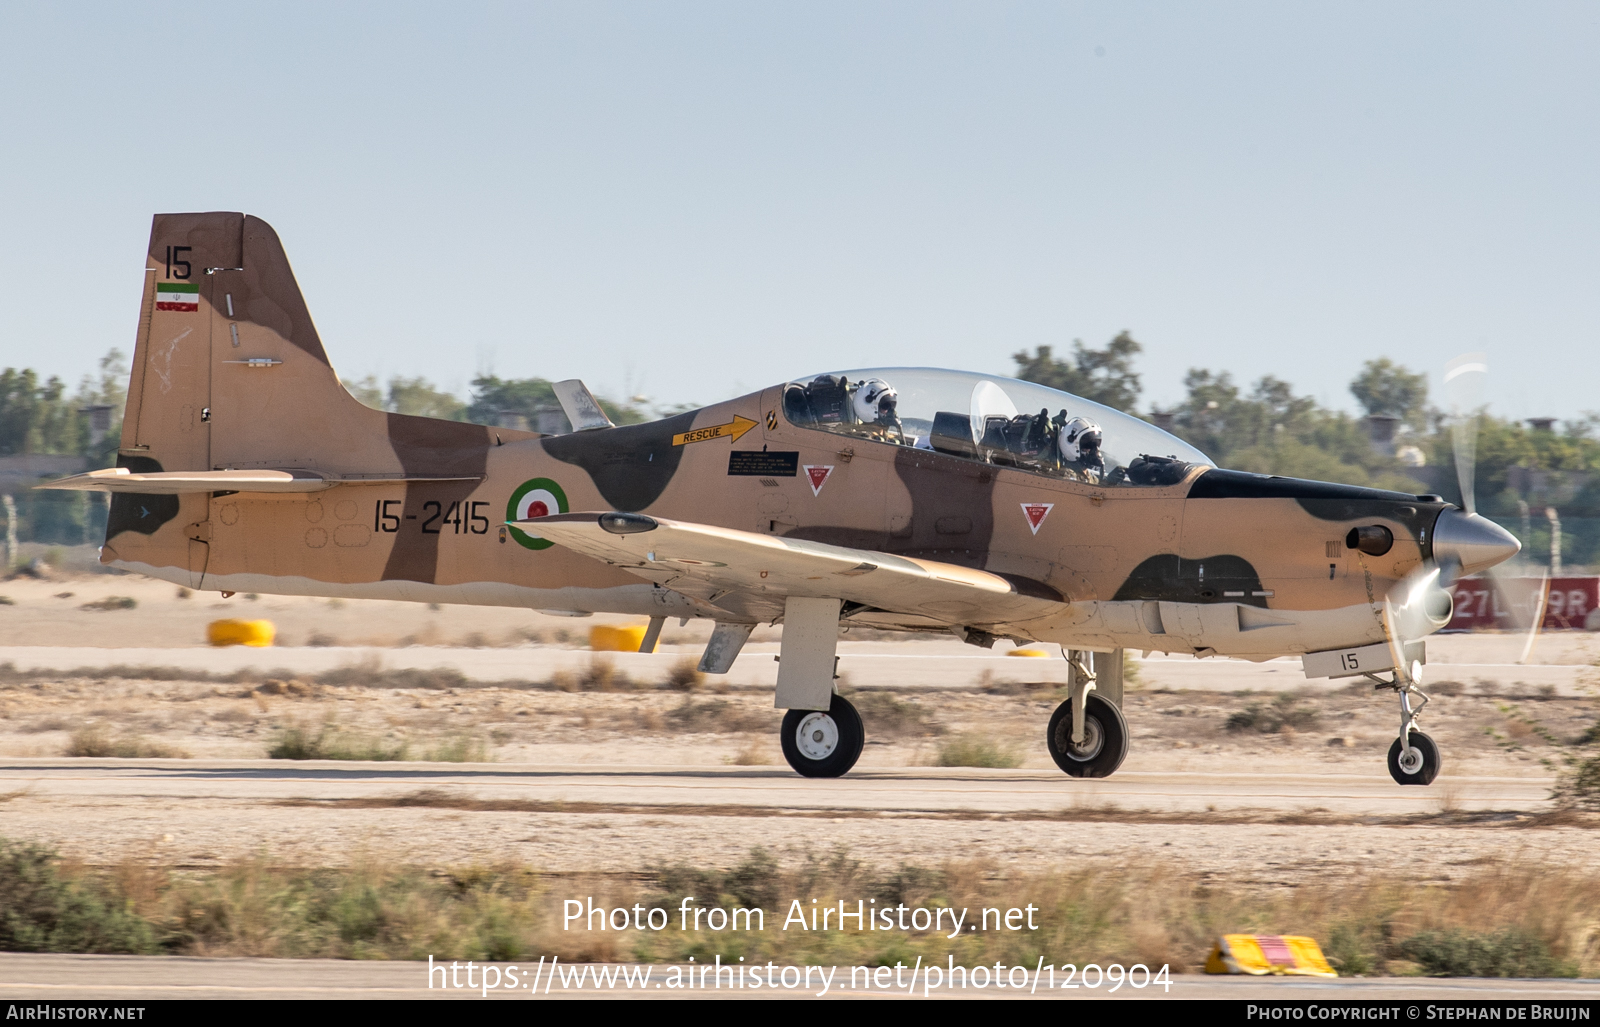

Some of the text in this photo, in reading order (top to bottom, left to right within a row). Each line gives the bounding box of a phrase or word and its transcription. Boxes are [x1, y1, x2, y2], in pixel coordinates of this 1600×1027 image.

[166, 246, 193, 280] 15
[683, 427, 722, 443] RESCUE
[375, 500, 490, 535] 15-2415
[1341, 653, 1359, 671] 15
